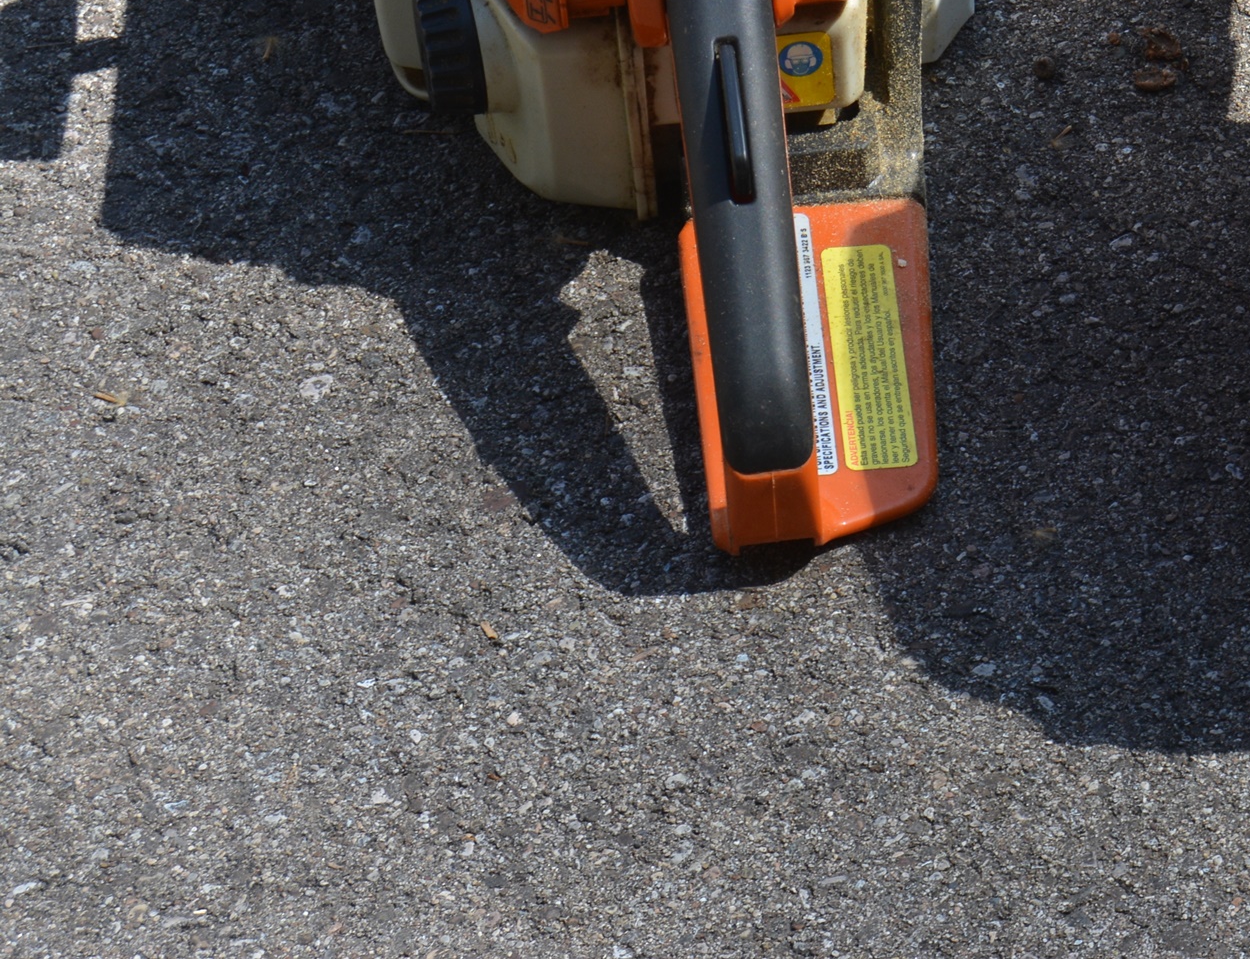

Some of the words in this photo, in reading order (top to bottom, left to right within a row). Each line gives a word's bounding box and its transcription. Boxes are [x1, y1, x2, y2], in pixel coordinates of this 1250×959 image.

[848, 268, 858, 287] riesgo
[869, 273, 878, 303] Manuales
[875, 321, 884, 346] Usuario
[811, 342, 825, 392] ADJUSTMENT.
[850, 361, 861, 391] peligrosa
[880, 359, 889, 383] Manual
[861, 372, 869, 390] forma
[817, 394, 827, 409] AND
[865, 391, 870, 400] en
[855, 404, 865, 425] puede
[897, 404, 903, 413] se
[868, 415, 873, 424] se
[869, 425, 874, 434] no
[888, 416, 893, 424] en
[819, 411, 834, 470] SPECIFICATIONS
[846, 410, 859, 467] ADVERTENCIA!
[857, 426, 866, 449] unidad
[898, 428, 911, 463] Seguridad
[860, 450, 868, 466] Esta
[871, 443, 880, 465] graves
[891, 451, 899, 464] leer
